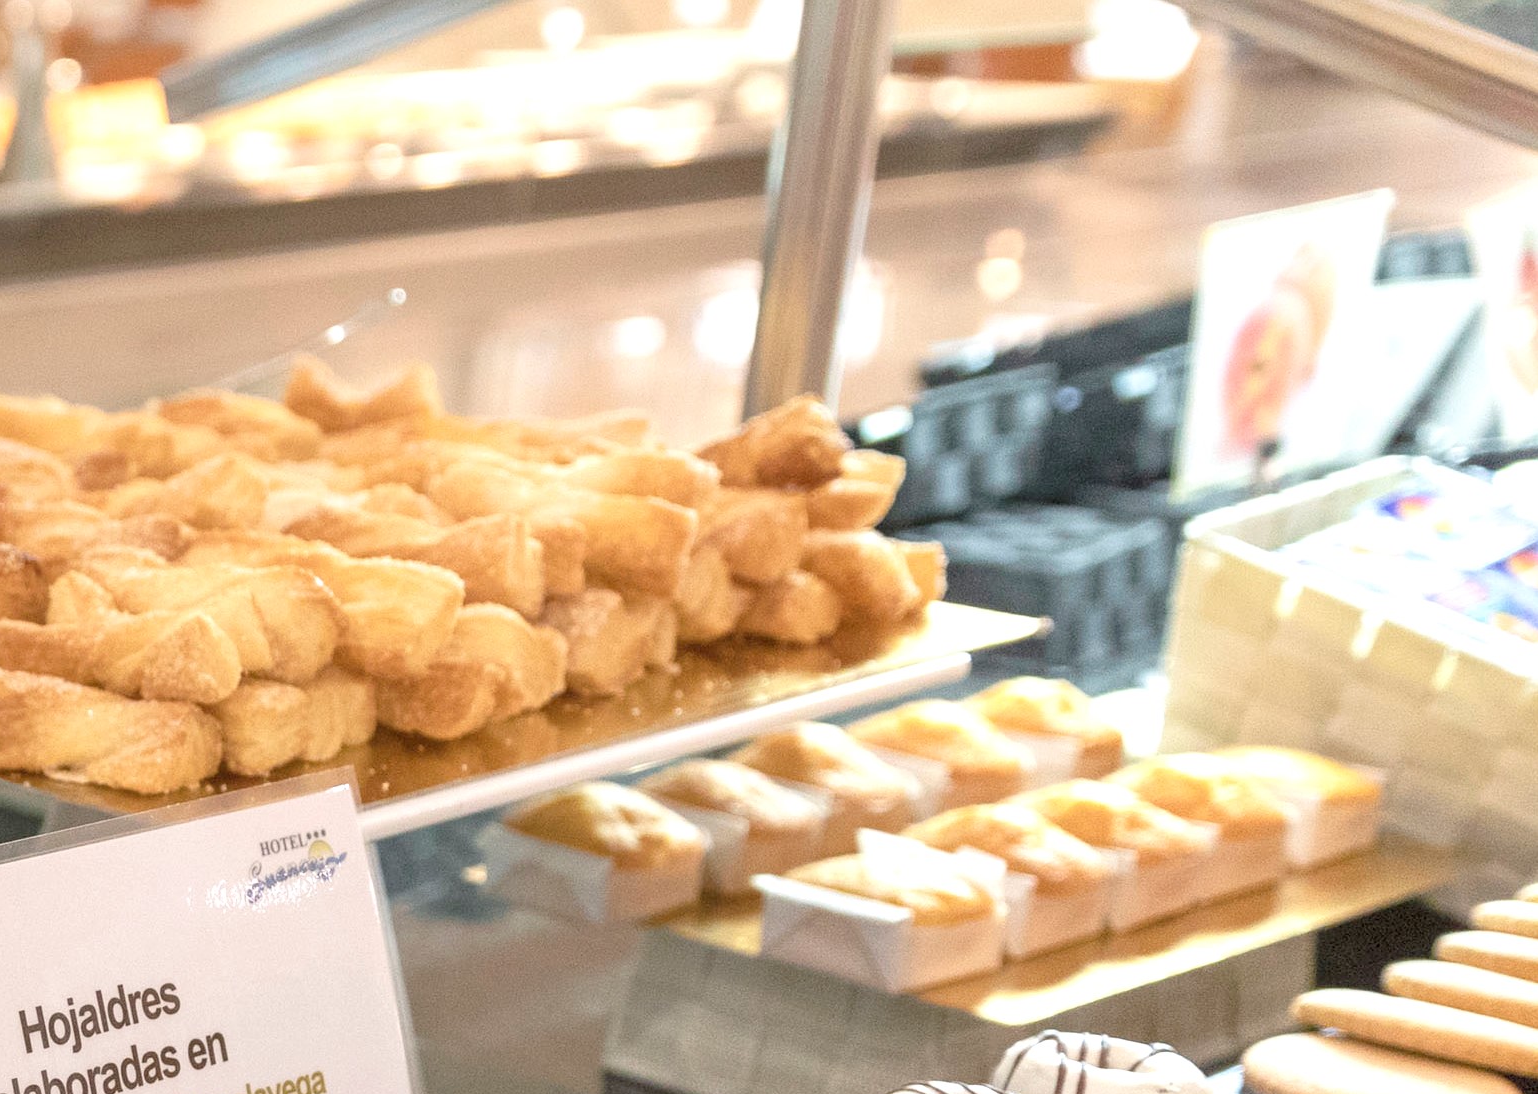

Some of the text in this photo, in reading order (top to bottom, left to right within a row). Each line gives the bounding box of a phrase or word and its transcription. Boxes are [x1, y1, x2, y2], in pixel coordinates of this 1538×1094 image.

[259, 833, 308, 857] HOTEL
[18, 982, 181, 1054] Hojaldres
[188, 1031, 229, 1071] en
